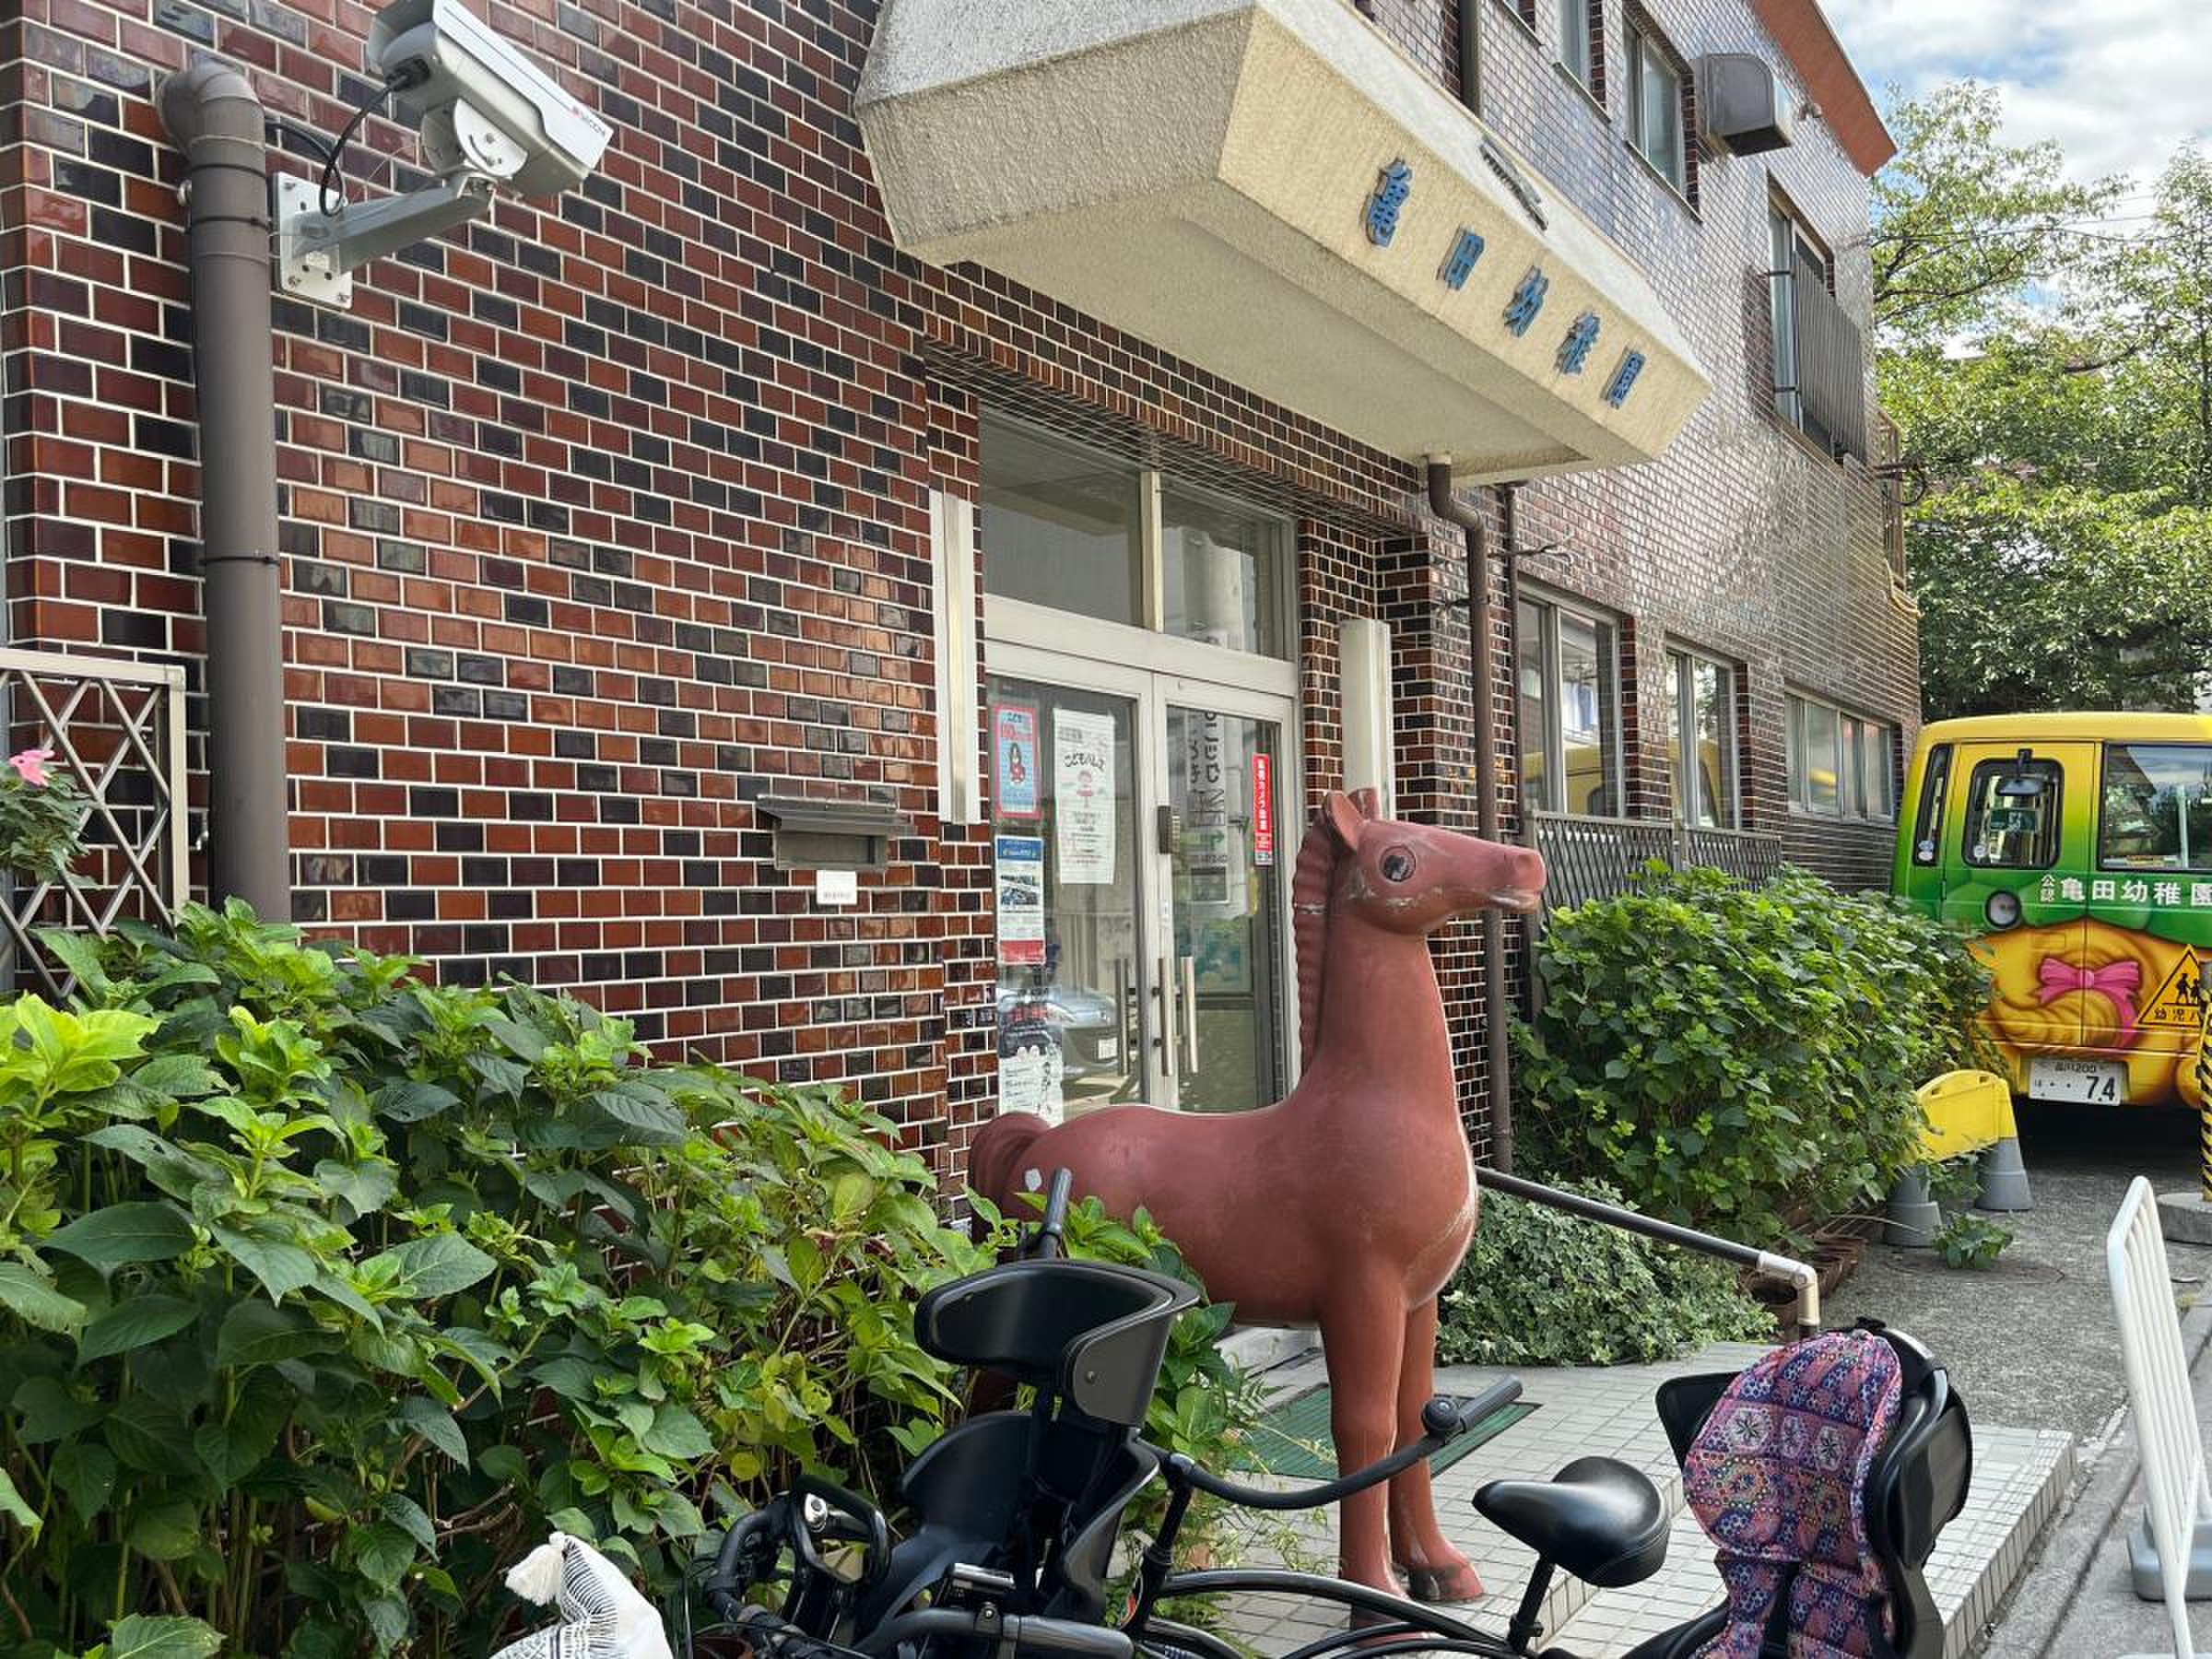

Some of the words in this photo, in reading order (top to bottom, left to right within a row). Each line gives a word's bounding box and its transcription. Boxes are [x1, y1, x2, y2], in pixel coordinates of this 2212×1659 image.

[2061, 877, 2212, 906] 亀田幼稚園
[2086, 1076, 2115, 1101] 74
